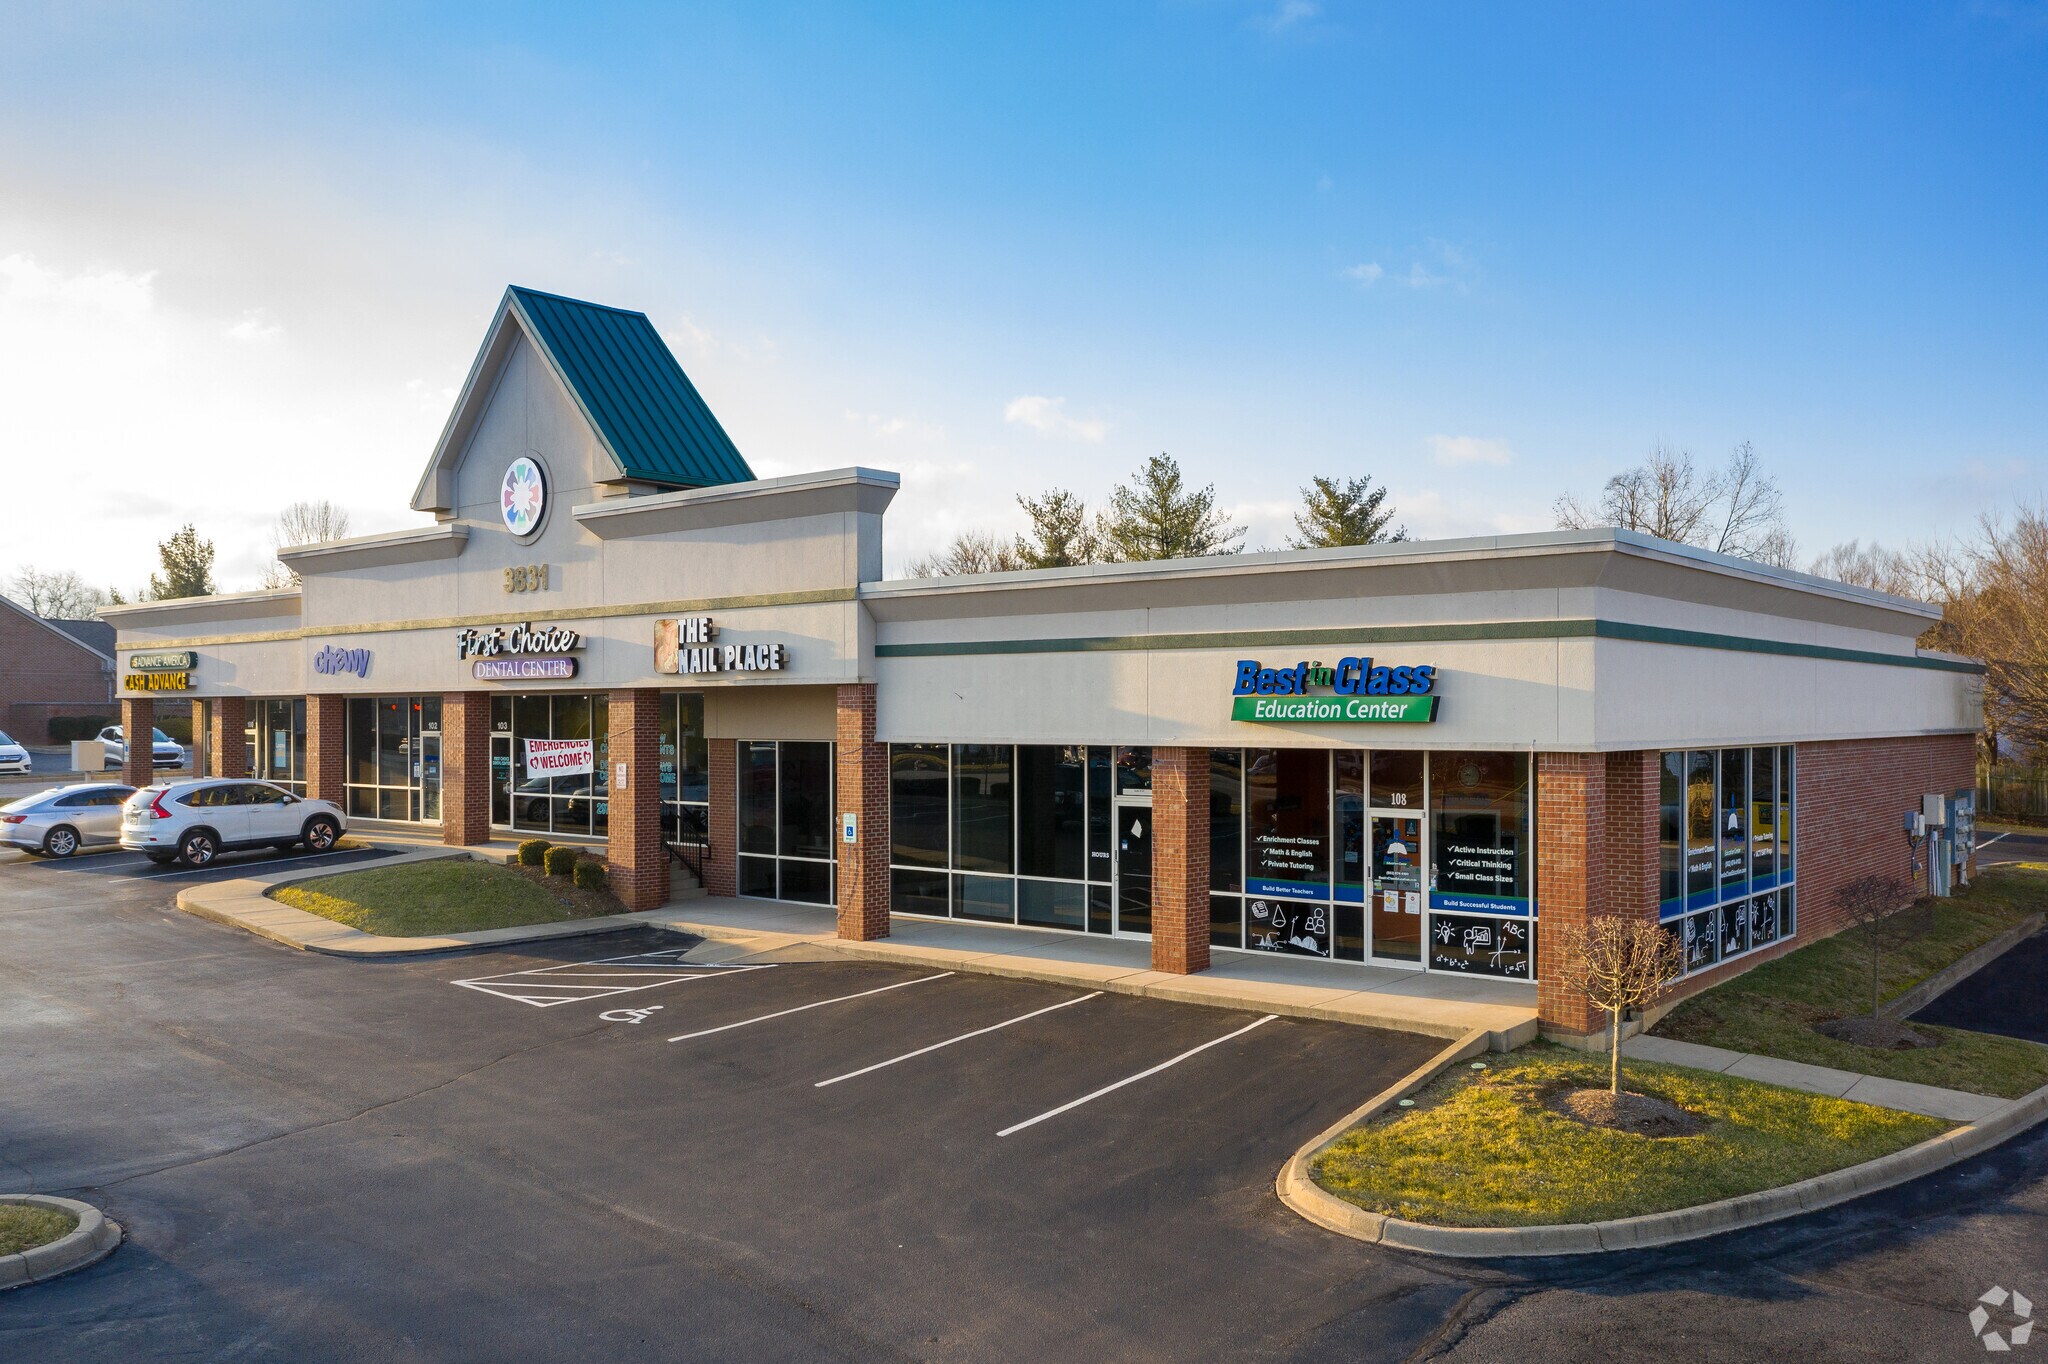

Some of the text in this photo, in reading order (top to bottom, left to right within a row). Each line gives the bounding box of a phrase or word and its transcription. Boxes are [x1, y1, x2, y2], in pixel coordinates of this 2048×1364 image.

[678, 618, 709, 643] THE
[458, 621, 576, 660] First Choice
[138, 654, 188, 667] ADVANCE AMERICA
[314, 644, 370, 678] chewy
[678, 644, 781, 673] NAIL PLACE
[476, 660, 569, 678] DENTAL CENTER
[124, 671, 187, 691] CASH ADVANCE
[1232, 657, 1435, 695] Best in Class
[1255, 700, 1408, 718] Education Center
[428, 722, 438, 730] 102
[497, 721, 508, 730] 103
[539, 752, 583, 769] WELCOME
[1391, 792, 1407, 806] 108
[1263, 835, 1296, 844] Enrichment
[1091, 851, 1110, 859] HOURS
[1269, 848, 1285, 856] Math
[1291, 850, 1312, 858] English
[1476, 847, 1514, 856] Instruction
[1268, 860, 1314, 871] Private Tutoring
[1456, 859, 1512, 871] Critical Thinking
[1455, 872, 1514, 883] Small Class Sizes
[1443, 899, 1516, 911] Build Successful Students
[1502, 920, 1525, 940] ABC
